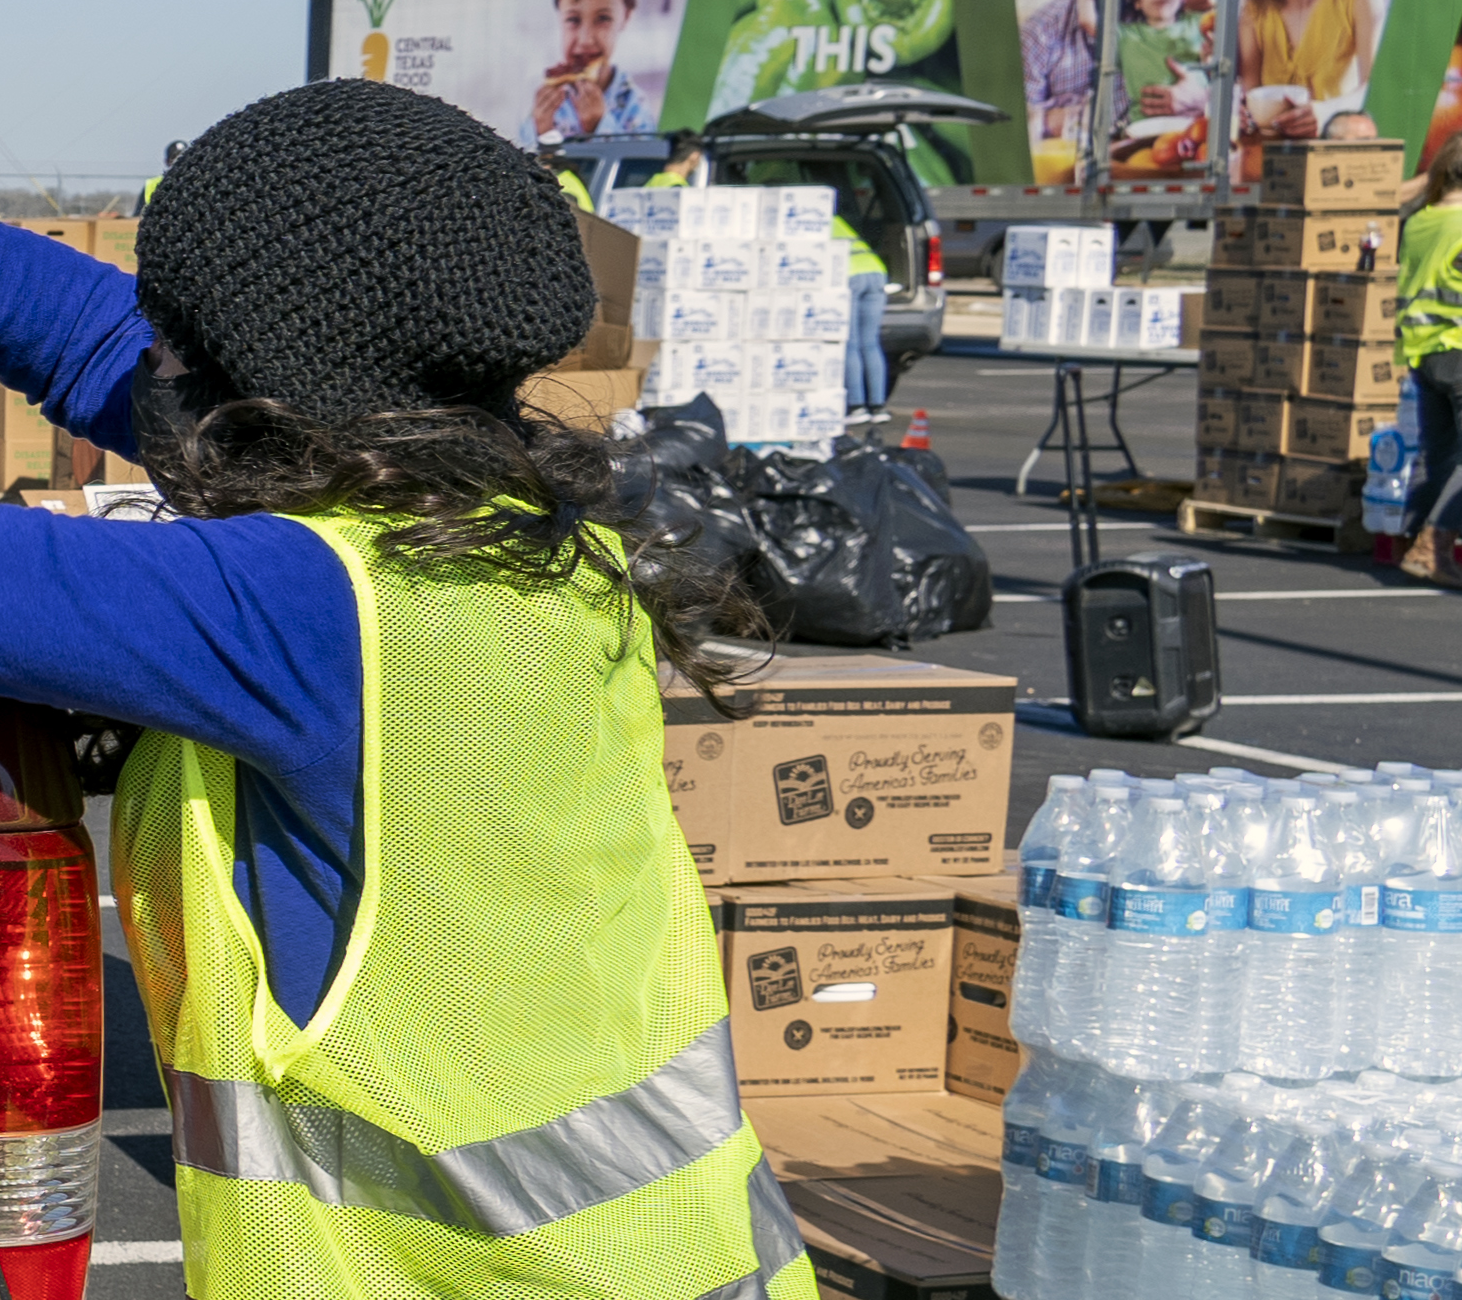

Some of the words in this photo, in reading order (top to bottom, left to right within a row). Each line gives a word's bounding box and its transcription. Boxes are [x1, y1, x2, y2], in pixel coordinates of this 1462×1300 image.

[395, 37, 454, 54] CENTRAL
[790, 23, 898, 73] THIS
[394, 55, 435, 71] TEXAS
[394, 71, 432, 88] FOOD
[849, 750, 910, 772] Proudly
[910, 744, 967, 765] Serving
[840, 770, 917, 794] America's
[919, 765, 978, 786] Families
[817, 942, 873, 961] Proudly
[875, 937, 925, 955] Serving
[809, 963, 880, 983] America's
[881, 955, 936, 975] Families
